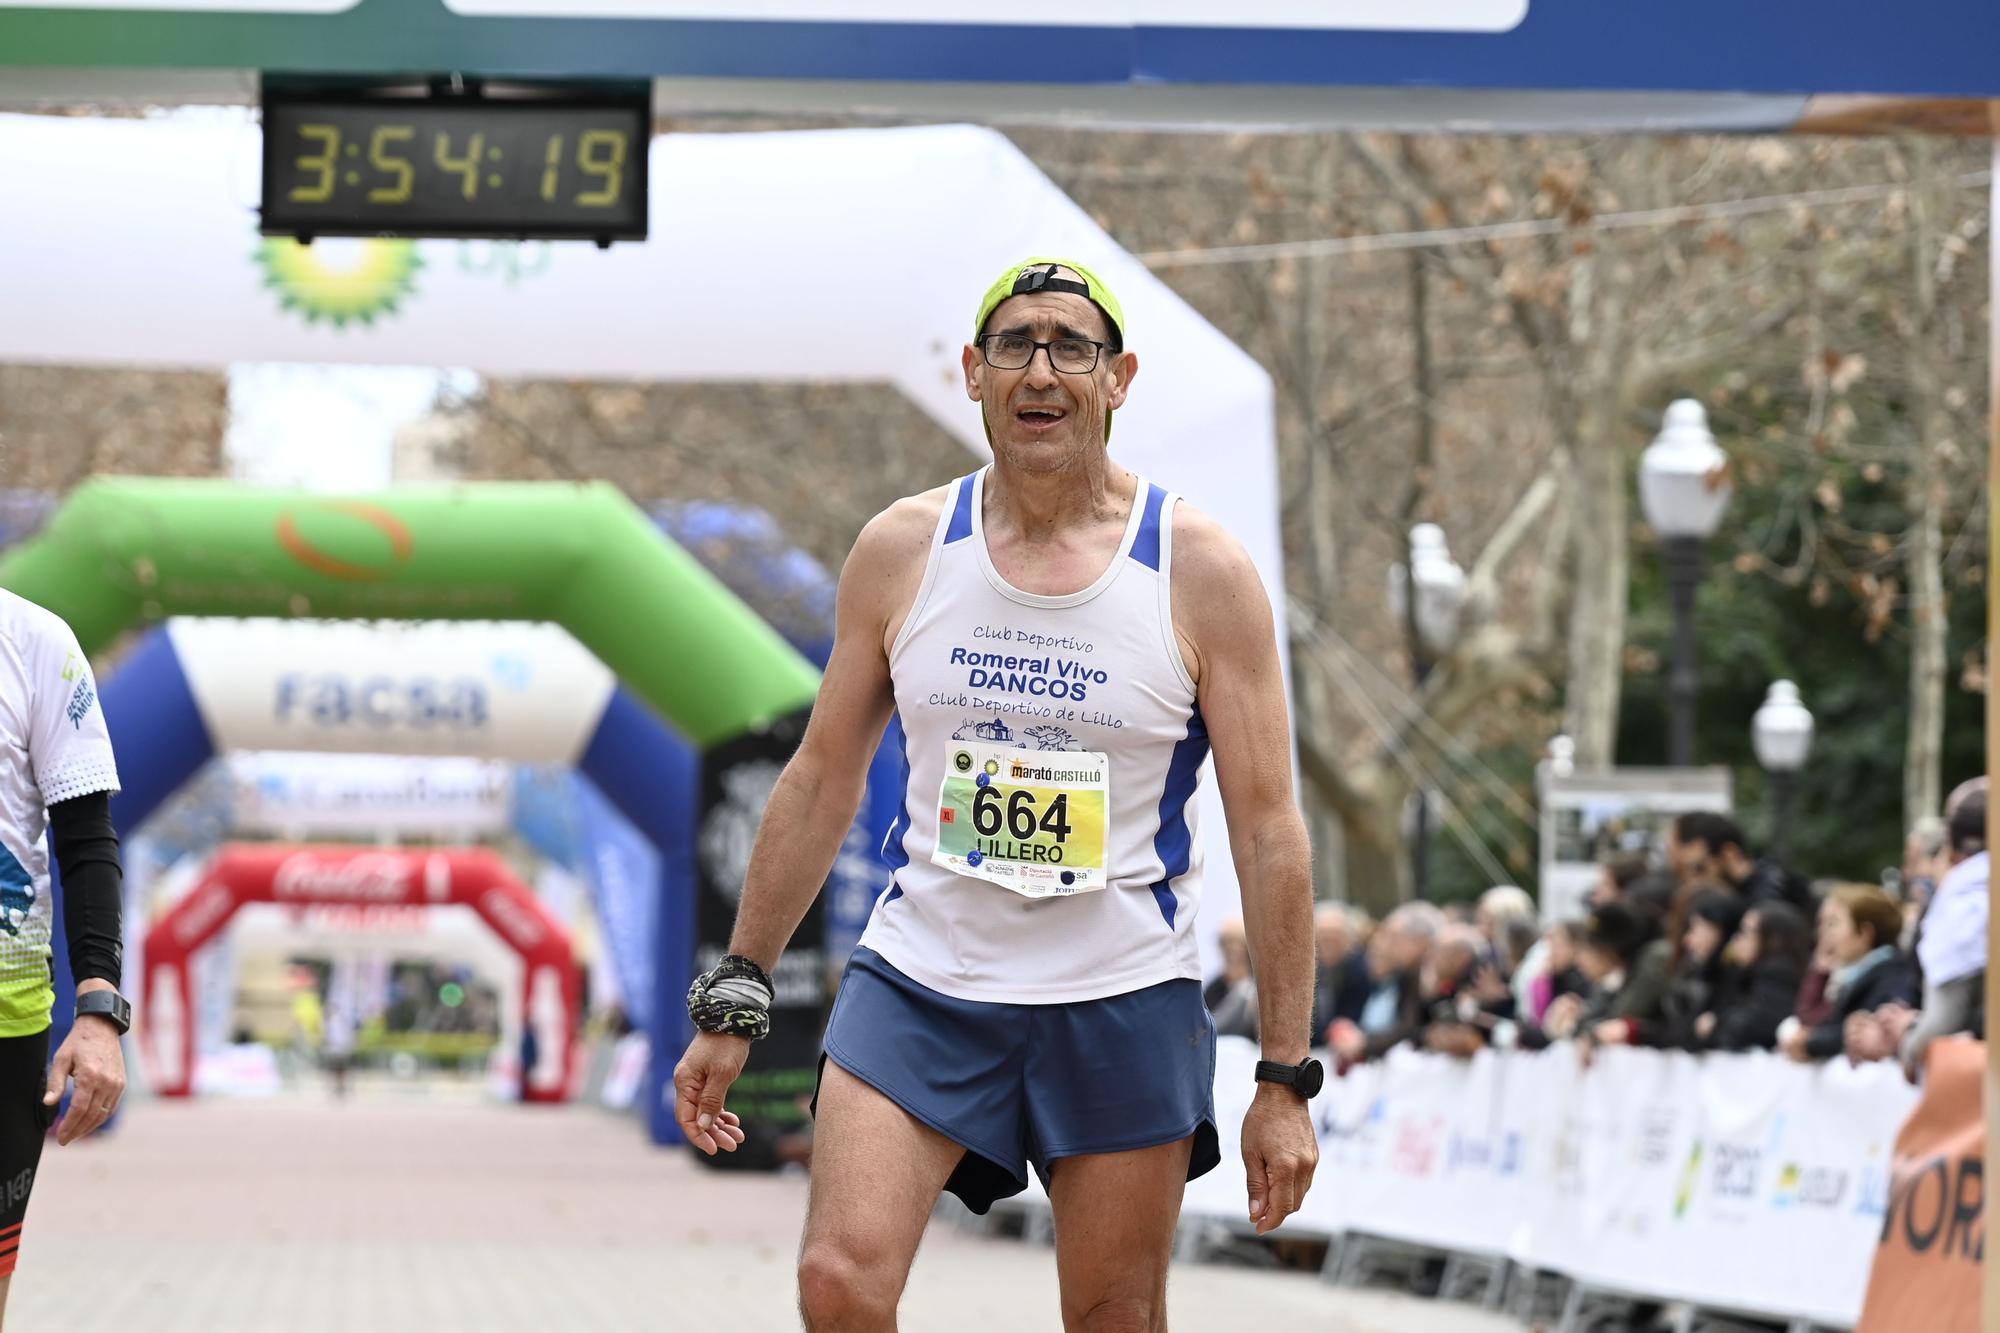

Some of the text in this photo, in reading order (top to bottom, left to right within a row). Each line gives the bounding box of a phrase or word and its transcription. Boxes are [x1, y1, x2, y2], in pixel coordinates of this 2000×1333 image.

[289, 125, 628, 206] 3:54:19
[973, 625, 1093, 653] Club Deportivo
[950, 647, 1108, 684] Romeral Vivo
[968, 668, 1087, 702] DANCOS
[928, 692, 1123, 729] Club Deportivo de Lillo
[1011, 765, 1101, 783] marató CASTELLÓ
[943, 810, 951, 821] XL
[972, 786, 1072, 843] 664
[977, 838, 1064, 864] LILLERO
